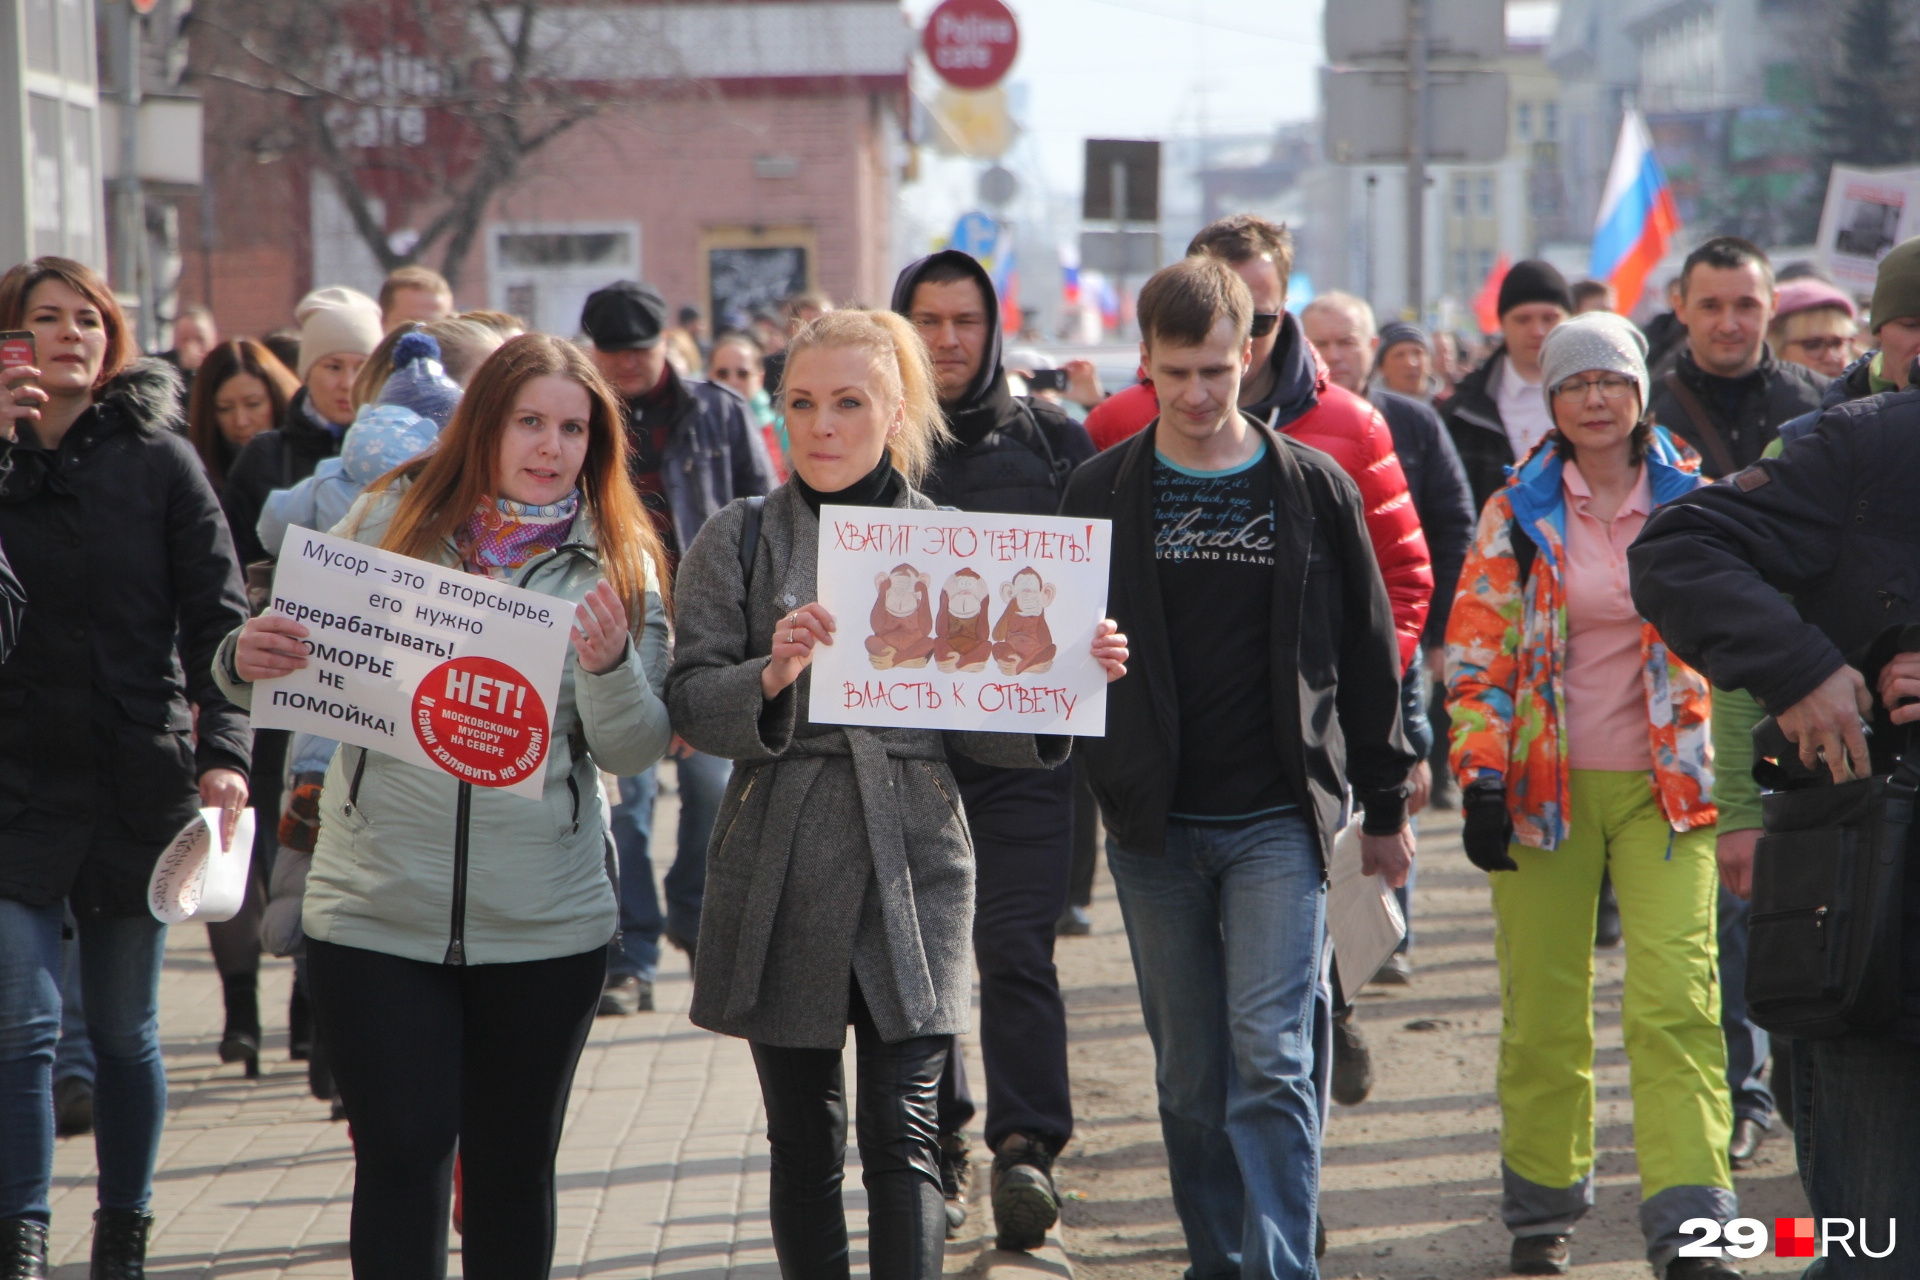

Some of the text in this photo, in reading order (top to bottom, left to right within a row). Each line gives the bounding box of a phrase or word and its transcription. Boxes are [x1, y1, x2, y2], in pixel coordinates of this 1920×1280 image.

[834, 521, 1093, 562] ХВАТИТ ЭТО ТЕРПЕТЬ!
[1155, 551, 1220, 560] UCKLAND
[302, 540, 369, 577] Мусор
[391, 569, 425, 589] это
[439, 581, 555, 628] вторсырье,
[273, 598, 455, 660] перерабатывать!
[369, 593, 484, 635] его нужно
[288, 637, 395, 678] ОМОРЬЕ
[319, 669, 345, 690] НЕ
[445, 668, 526, 719] НЕТ!
[273, 691, 395, 737] ПОМОЙКА!
[843, 681, 1077, 720] ВЛАСТЬ К ОТВЕТУ
[441, 709, 519, 738] МОСКОВСКОМУ
[458, 725, 501, 744] МУСОРУ
[418, 709, 438, 745] сами
[432, 745, 497, 781] халявить
[499, 765, 517, 780] не
[515, 726, 542, 771] будем!
[451, 735, 505, 757] НА СЕВЕРЕ
